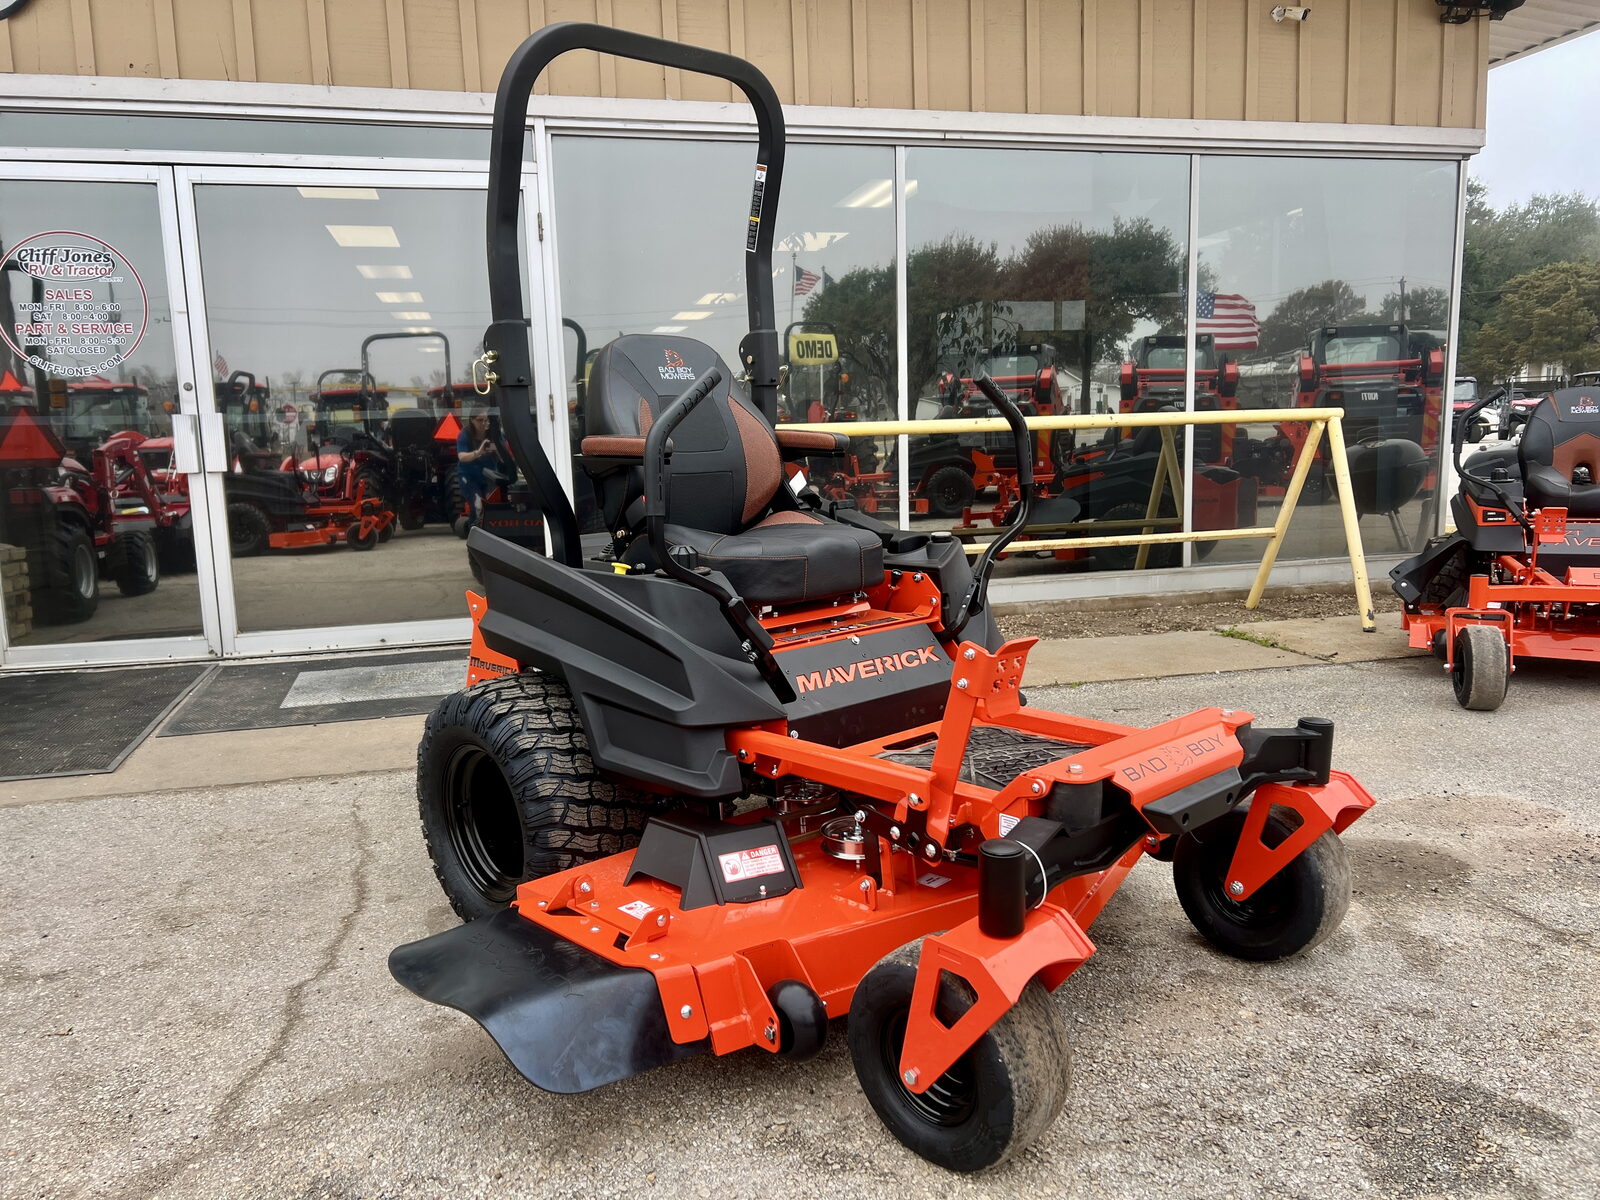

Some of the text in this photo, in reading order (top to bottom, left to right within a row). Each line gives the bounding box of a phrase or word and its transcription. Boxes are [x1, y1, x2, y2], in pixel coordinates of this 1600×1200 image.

[17, 248, 111, 265] Cliff Jones
[29, 264, 113, 275] RV & Tractor
[46, 289, 92, 300] SALES
[16, 324, 133, 334] PART & SERVICE
[25, 337, 46, 345] MON
[55, 337, 71, 345] FRI
[80, 337, 98, 345] 8:00
[108, 337, 126, 345] 5:30
[30, 354, 123, 376] CLIFFJONES.COM
[796, 646, 941, 693] MAVERICK
[1122, 734, 1224, 782] BAD BOY
[750, 847, 777, 858] DANGER
